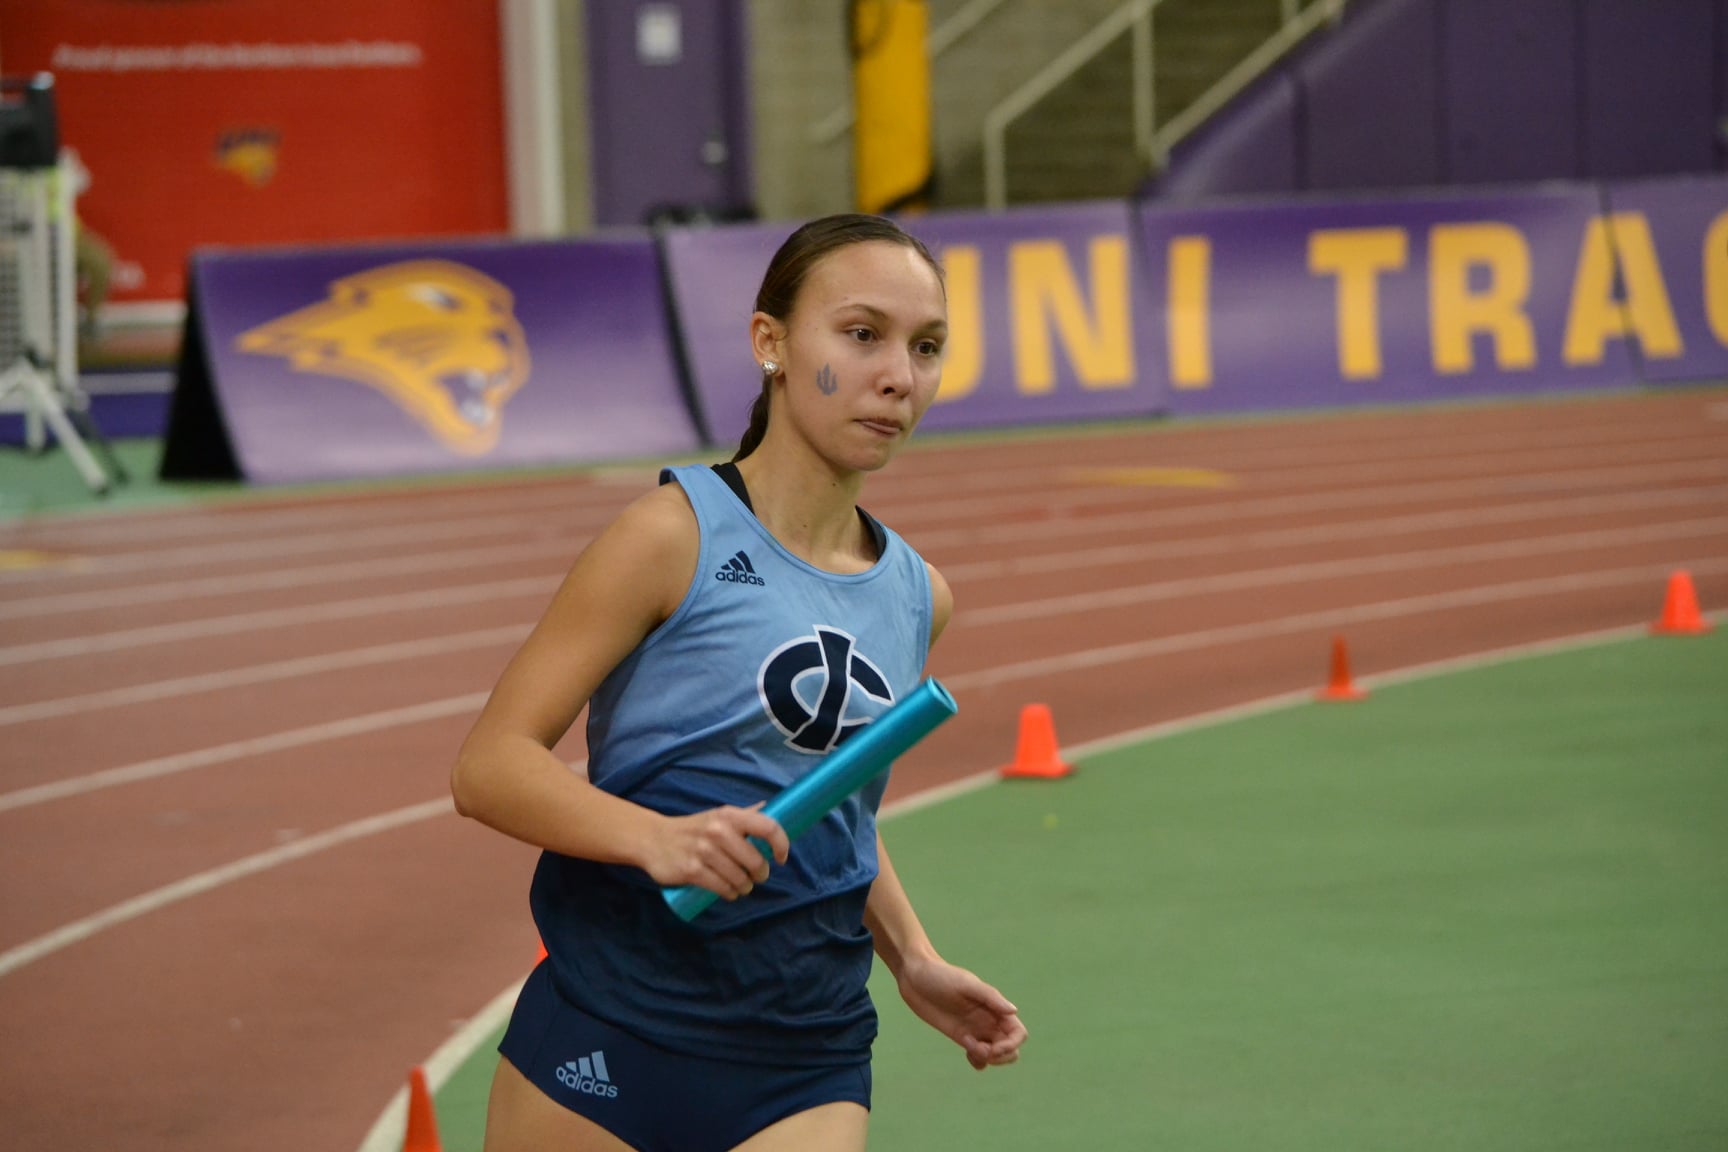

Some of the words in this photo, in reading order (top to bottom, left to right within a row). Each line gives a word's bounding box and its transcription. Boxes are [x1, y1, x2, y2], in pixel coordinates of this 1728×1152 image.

[1307, 208, 1728, 382] TRA
[715, 568, 766, 587] adidas
[555, 1066, 619, 1098] adidas
